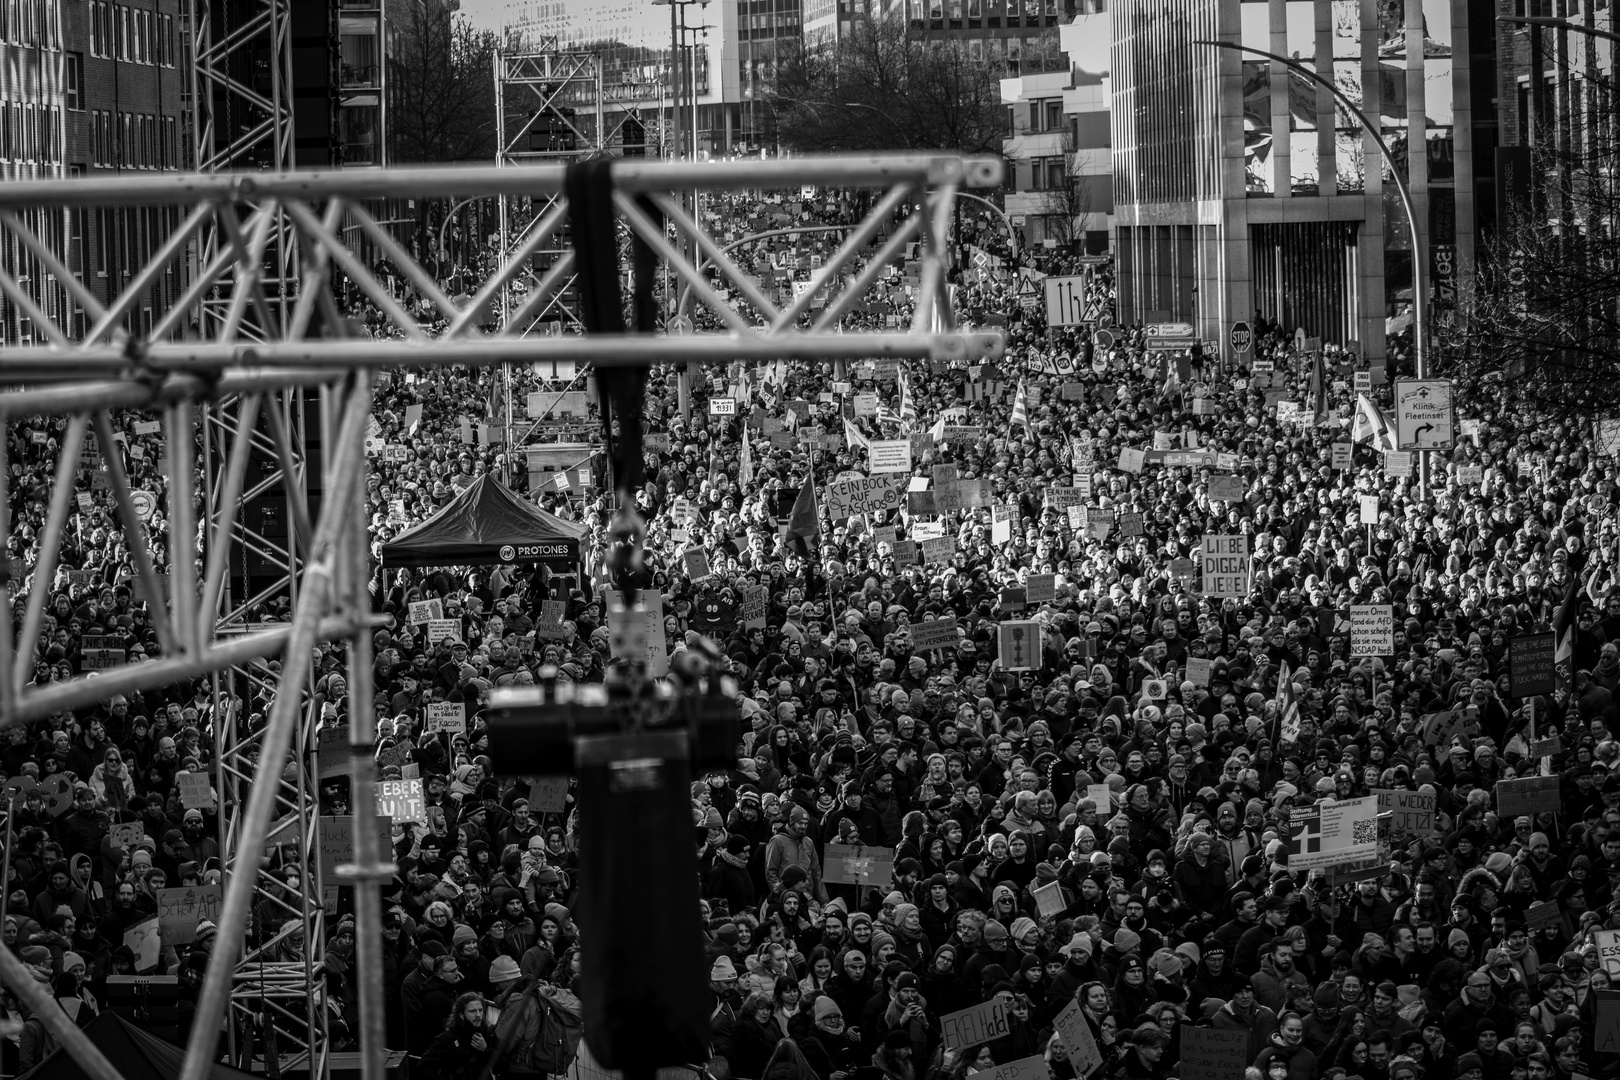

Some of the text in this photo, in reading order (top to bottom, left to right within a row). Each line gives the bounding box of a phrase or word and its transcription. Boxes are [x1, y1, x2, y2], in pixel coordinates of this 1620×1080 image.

[1504, 160, 1514, 213] FLEETINSEL
[1232, 330, 1250, 344] STOP
[1413, 402, 1435, 414] Klinik
[1405, 413, 1444, 422] Fleetinsel
[830, 476, 892, 498] KEIN BOCK
[850, 490, 871, 503] AUF
[840, 499, 888, 518] FASCHOS
[518, 544, 568, 556] PROTONES
[1206, 537, 1244, 554] LIEBE
[1205, 557, 1247, 574] DIGGA
[1205, 577, 1248, 593] LIEBE!
[542, 601, 561, 609] KEIN
[542, 608, 562, 616] BIER
[1350, 607, 1388, 616] meine Oma
[914, 622, 945, 633] FASCHISMUS
[1350, 616, 1392, 628] fand die AfD
[541, 624, 563, 633] NAZIS
[1351, 627, 1369, 636] schon
[83, 637, 101, 649] NIE
[915, 633, 959, 647] EIN VERBRECHEN
[1351, 636, 1388, 645] als sie noch
[1511, 638, 1554, 653] SAVE THE BEES
[98, 649, 110, 658] IST
[1351, 645, 1377, 655] NSDAP
[89, 656, 118, 669] JETZT
[1511, 665, 1528, 675] CLEAN
[1537, 662, 1552, 671] SEAS
[1513, 676, 1530, 685] FUCK
[438, 717, 461, 728] Racism
[1432, 722, 1444, 736] IM
[382, 798, 421, 817] UNT
[1398, 794, 1434, 811] WIEDER
[1289, 807, 1313, 815] Stiftung
[1289, 811, 1319, 820] Warentest
[1289, 820, 1305, 828] test
[1396, 811, 1435, 830] JETZT
[1182, 1027, 1243, 1044] ICH WOLLTE
[1182, 1043, 1196, 1053] INS
[1182, 1057, 1240, 1070] WEGEN EUCH
